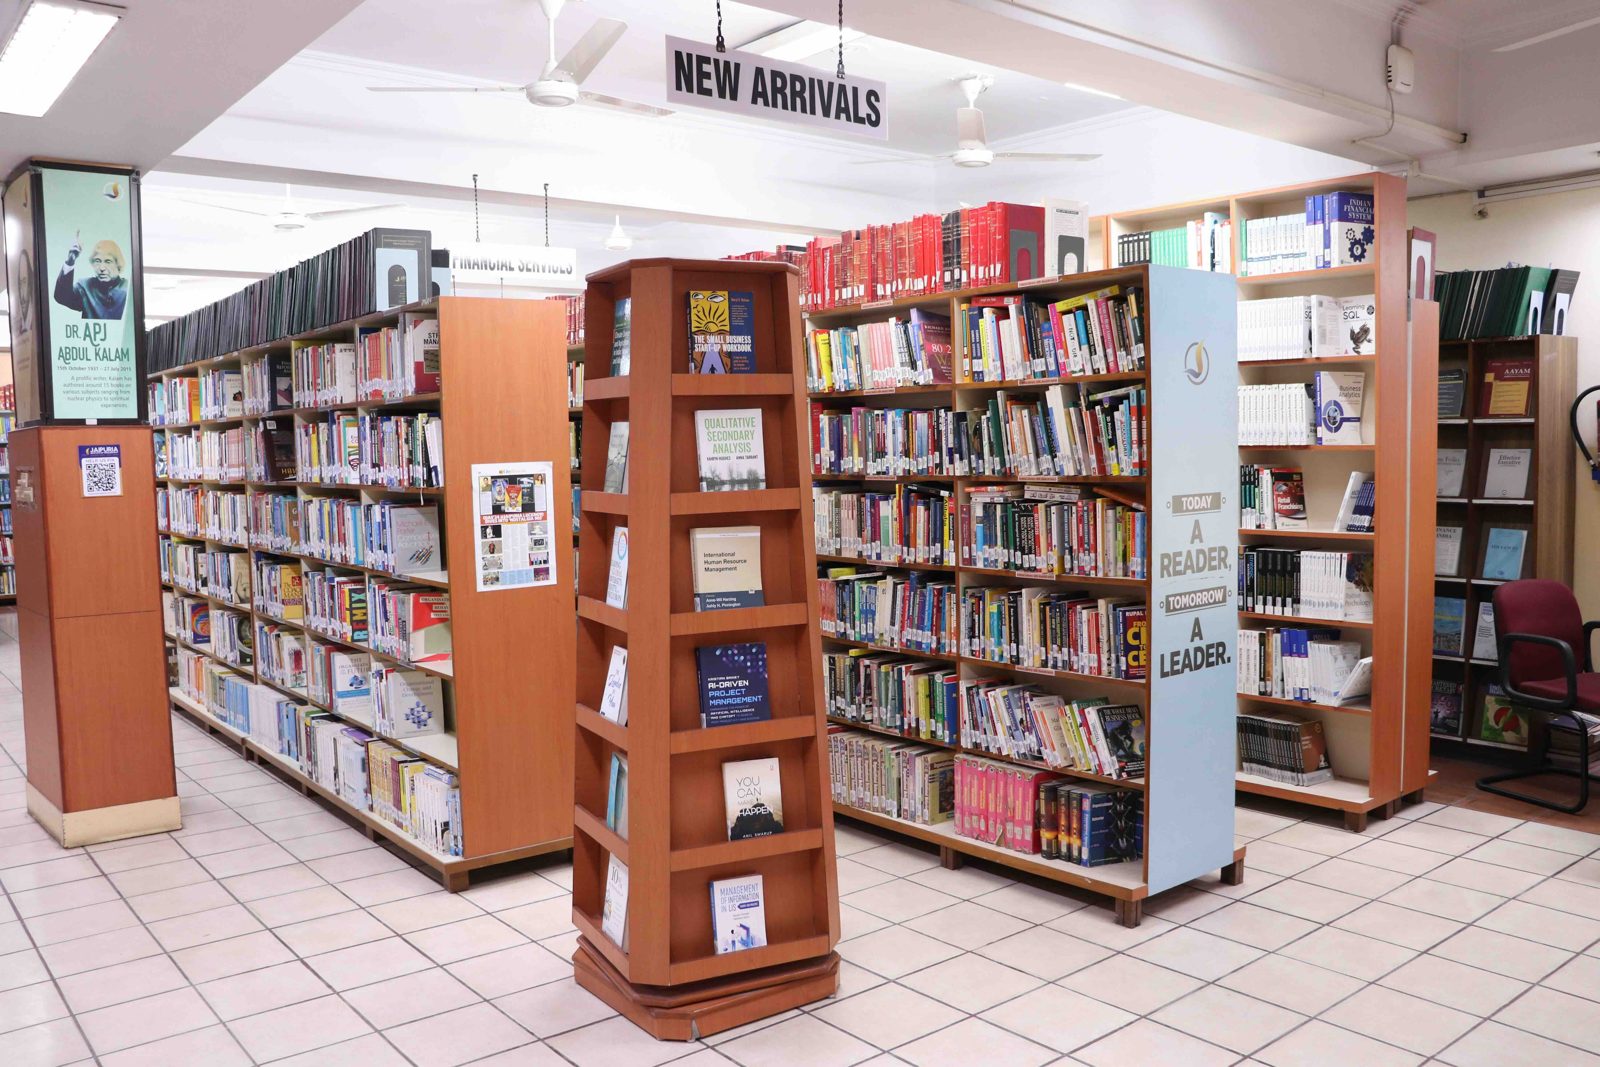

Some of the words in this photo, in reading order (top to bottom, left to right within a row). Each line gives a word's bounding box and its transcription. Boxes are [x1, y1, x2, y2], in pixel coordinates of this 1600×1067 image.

[674, 50, 741, 102] NEW
[750, 66, 881, 128] ARRIVALS
[1350, 199, 1371, 207] INDIAN
[1348, 212, 1372, 220] SYSTEM
[452, 256, 514, 272] FINANCIAL
[518, 259, 573, 275] SERVICES
[1343, 311, 1360, 320] SQL
[66, 324, 82, 338] DR.
[82, 322, 107, 346] APJ
[694, 335, 705, 344] THE
[706, 335, 724, 344] SMALL
[726, 335, 752, 344] BUSINESS
[694, 344, 721, 352] START-UP
[723, 344, 752, 352] WORKBOOK
[58, 346, 91, 365] ABDUL
[94, 347, 130, 362] KALAM
[704, 417, 756, 430] QUALITATIVE
[707, 430, 755, 442] SECONDARY
[713, 442, 752, 454] ANALYSIS
[1182, 495, 1212, 511] TODAY
[1190, 519, 1203, 544] A
[1160, 546, 1232, 579] READER,
[1168, 590, 1224, 610] TOMORROW
[352, 592, 368, 640] REMIX
[1190, 616, 1203, 642] A
[1160, 641, 1231, 679] LEADER.
[708, 680, 749, 689] AI-DRIVEN
[709, 688, 746, 698] PROJECT
[710, 696, 763, 706] MANAGEMENT
[736, 776, 760, 787] YOU
[737, 787, 761, 798] CAN
[720, 883, 759, 896] MANAGEMENT
[728, 892, 760, 902] INFORMATION
